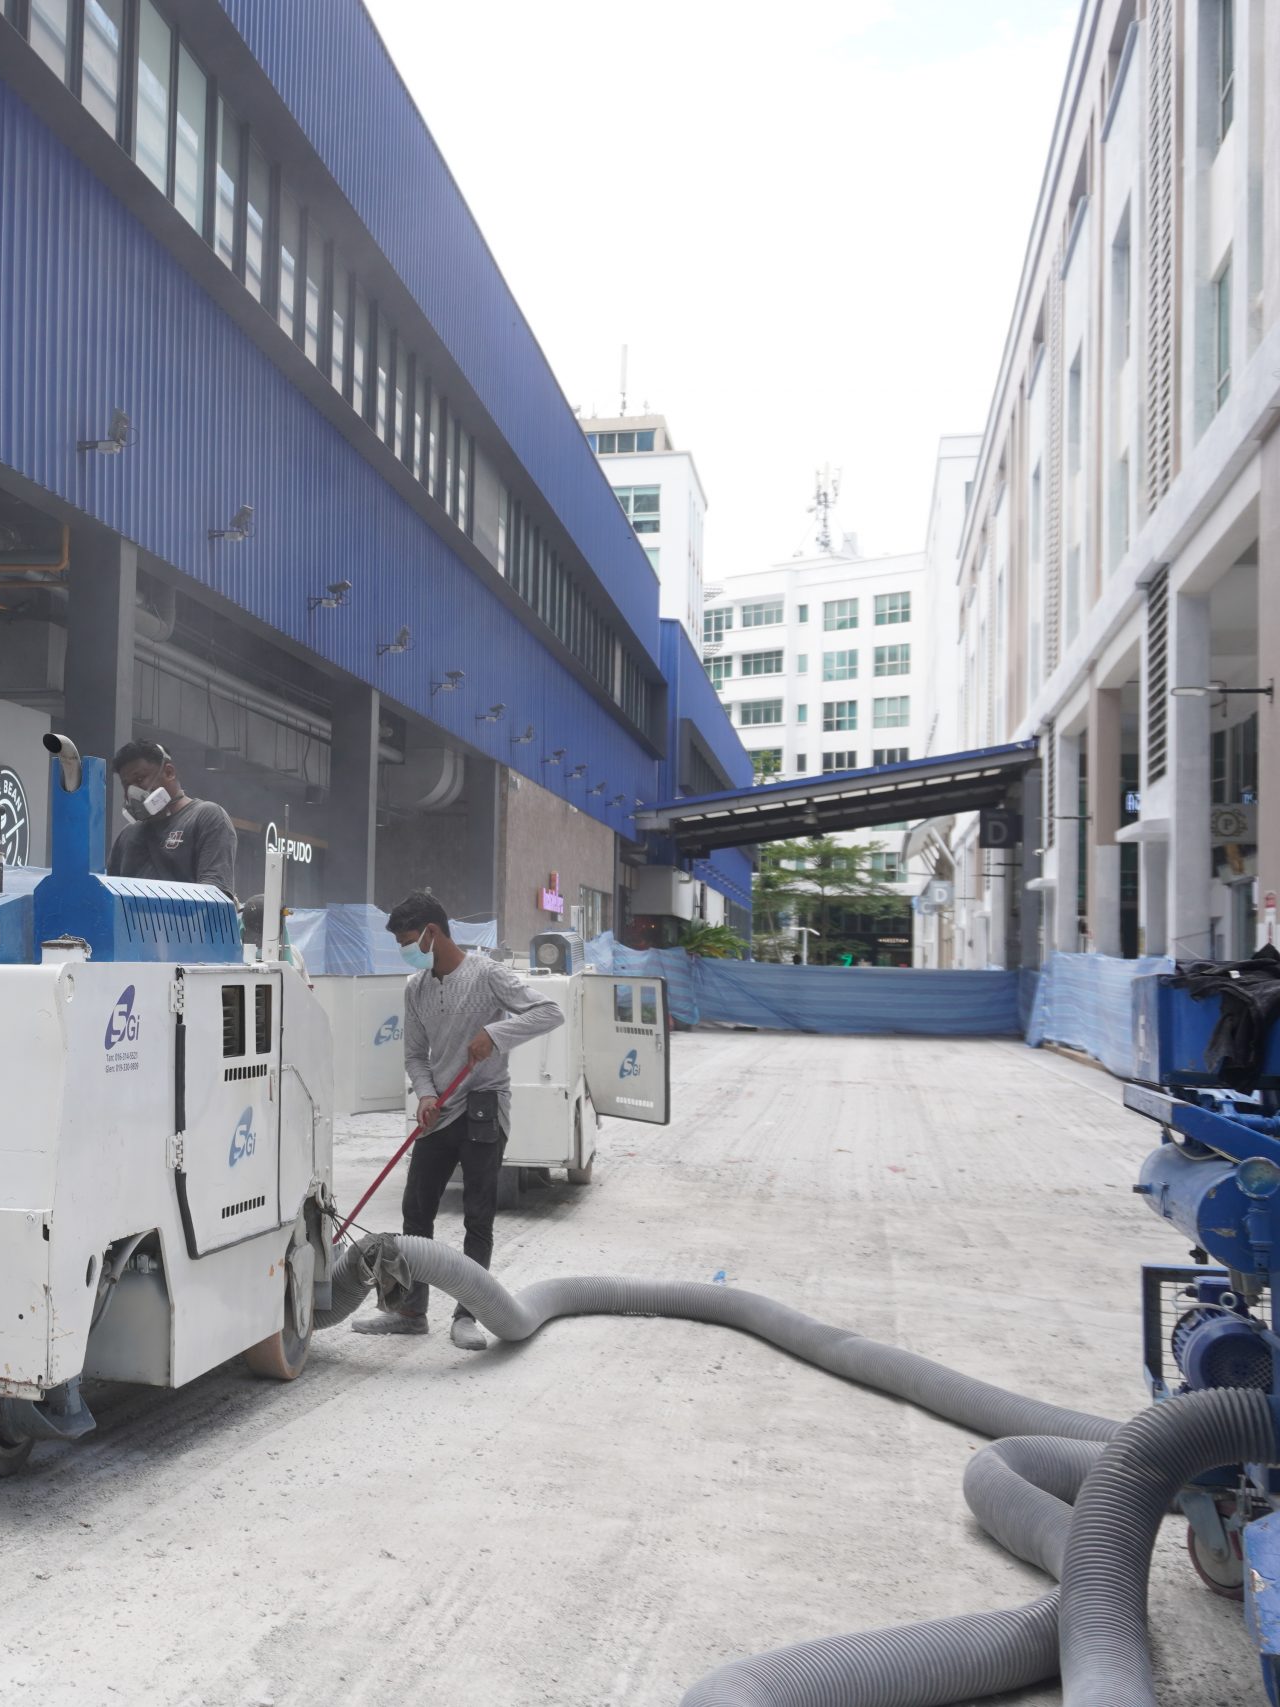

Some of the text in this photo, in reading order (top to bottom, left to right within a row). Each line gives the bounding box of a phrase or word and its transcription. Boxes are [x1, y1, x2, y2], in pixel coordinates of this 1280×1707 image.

[3, 779, 23, 812] BEAN
[988, 821, 1009, 844] D
[935, 887, 948, 903] D
